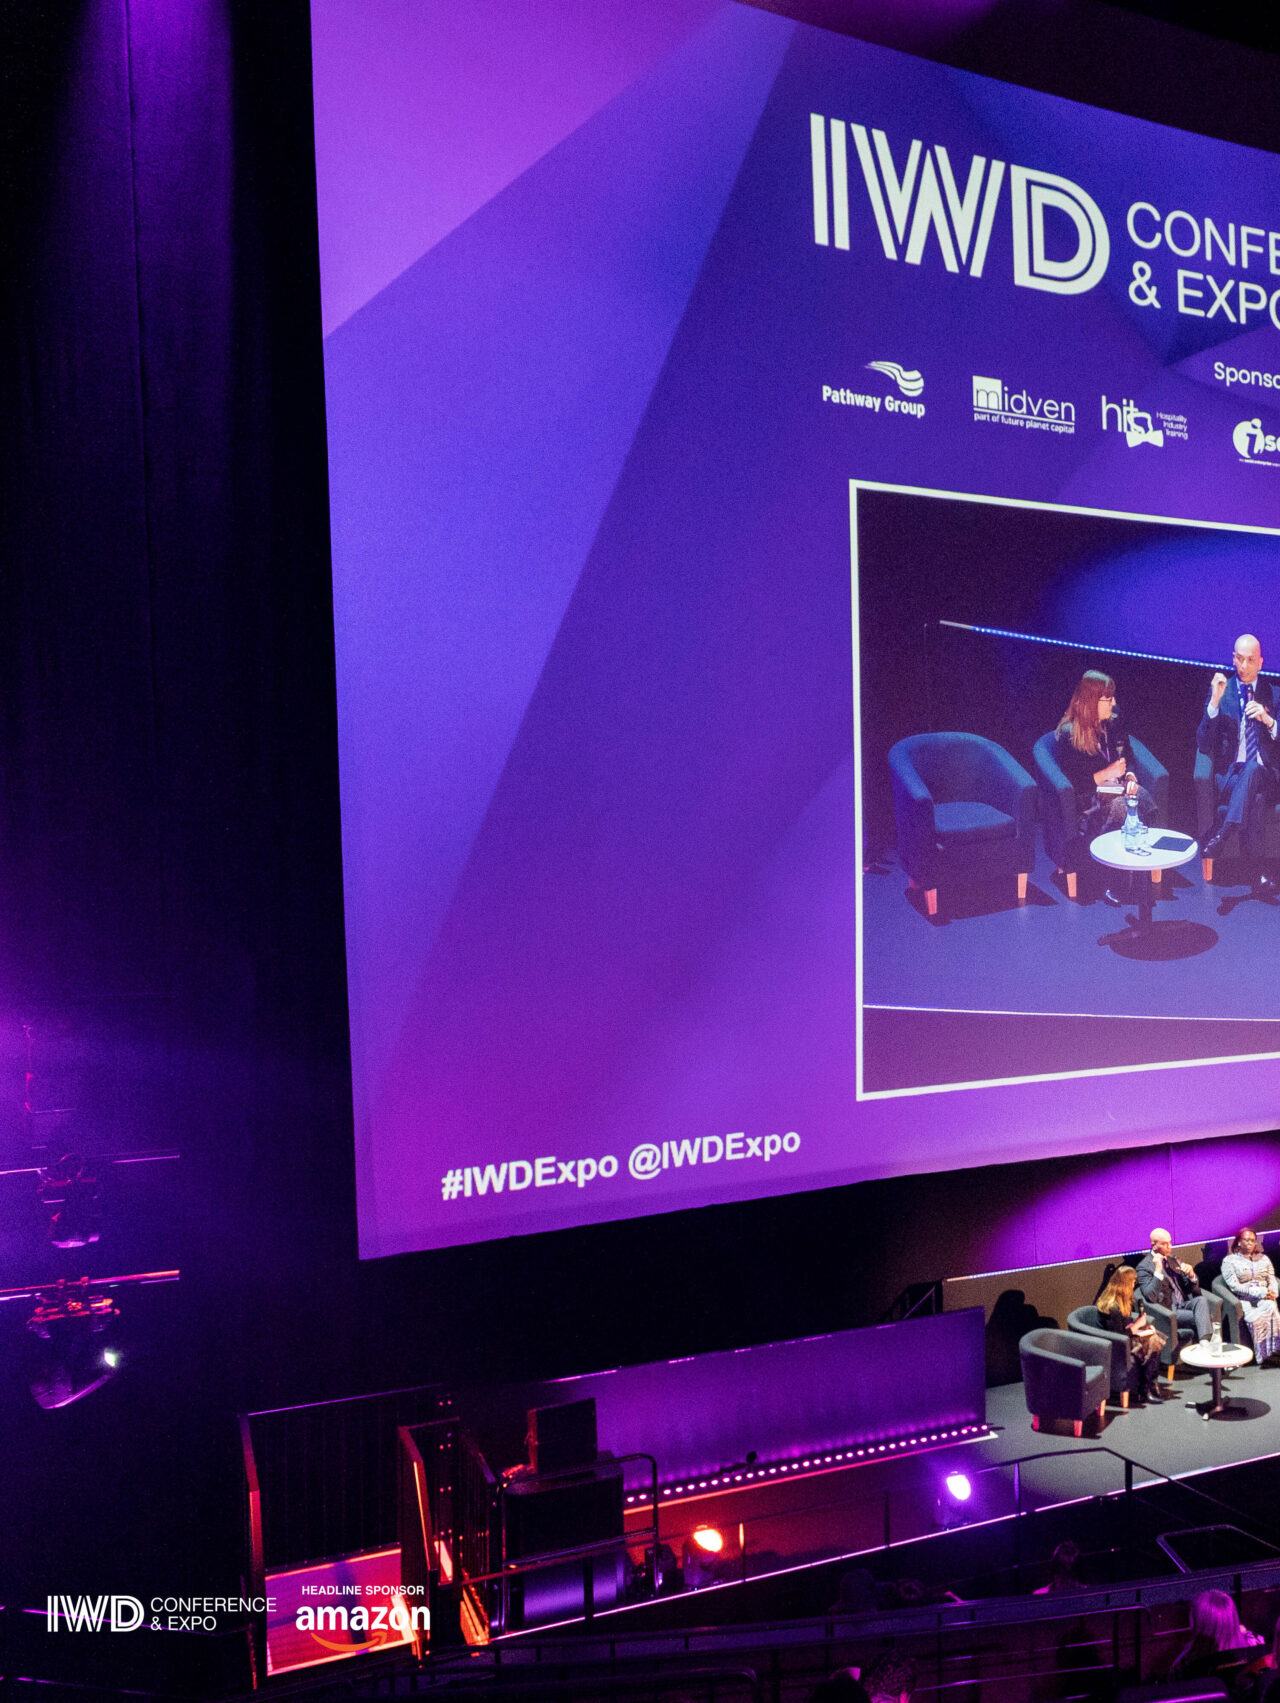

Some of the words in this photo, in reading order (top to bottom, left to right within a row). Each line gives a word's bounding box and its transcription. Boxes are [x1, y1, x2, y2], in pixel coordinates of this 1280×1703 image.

[810, 113, 1110, 295] IWD
[1128, 261, 1162, 309] &
[822, 385, 881, 412] Pathway
[884, 395, 926, 418] Group
[975, 384, 1075, 422] midven
[974, 413, 990, 422] part
[991, 414, 1000, 423] of
[1001, 414, 1024, 427] future
[1026, 419, 1049, 431] planet
[1050, 424, 1075, 435] capital
[1162, 420, 1188, 432] Industry
[1165, 428, 1189, 441] Training
[442, 1155, 618, 1201] #IWDExpo
[628, 1131, 801, 1180] @IWDExpo
